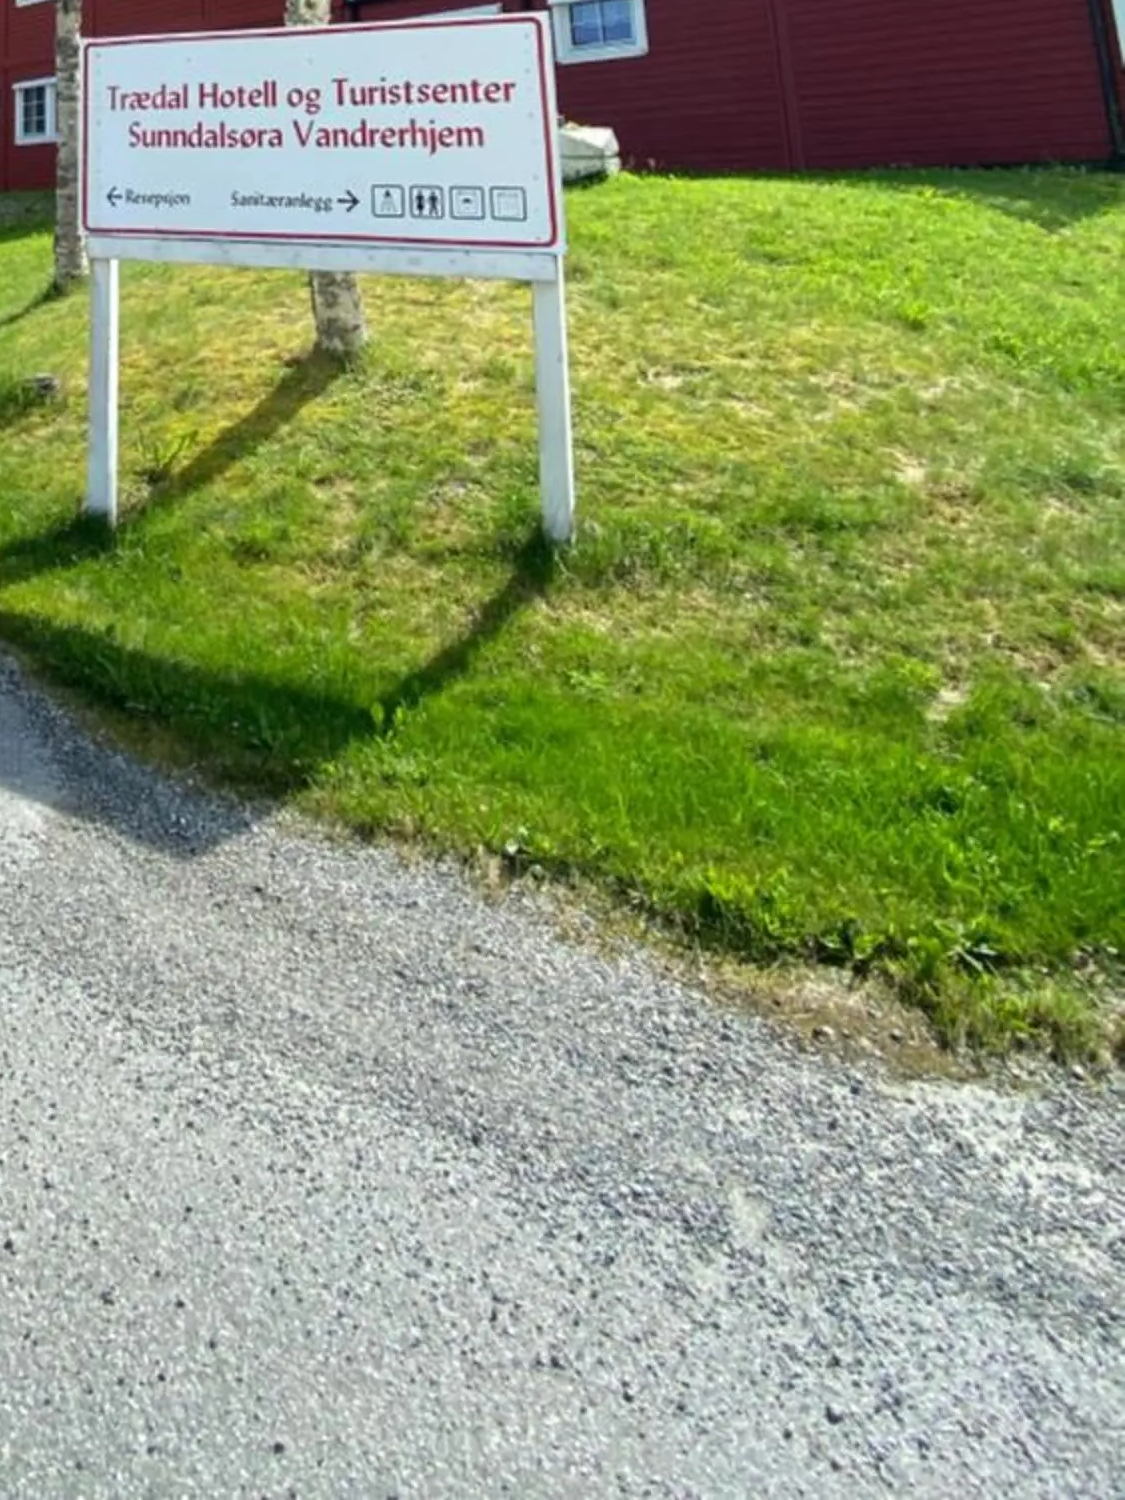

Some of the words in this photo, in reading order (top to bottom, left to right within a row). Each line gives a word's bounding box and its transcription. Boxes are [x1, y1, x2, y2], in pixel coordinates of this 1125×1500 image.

[107, 84, 189, 111] Trædal
[198, 80, 278, 109] Hotell
[287, 86, 321, 114] og
[332, 77, 516, 107] Turistsenter
[128, 120, 283, 149] Sunndalsøra
[293, 119, 484, 155] Vandrerhjem
[126, 189, 191, 207] Resepsjon
[231, 190, 333, 212] Sanitæranlegg
